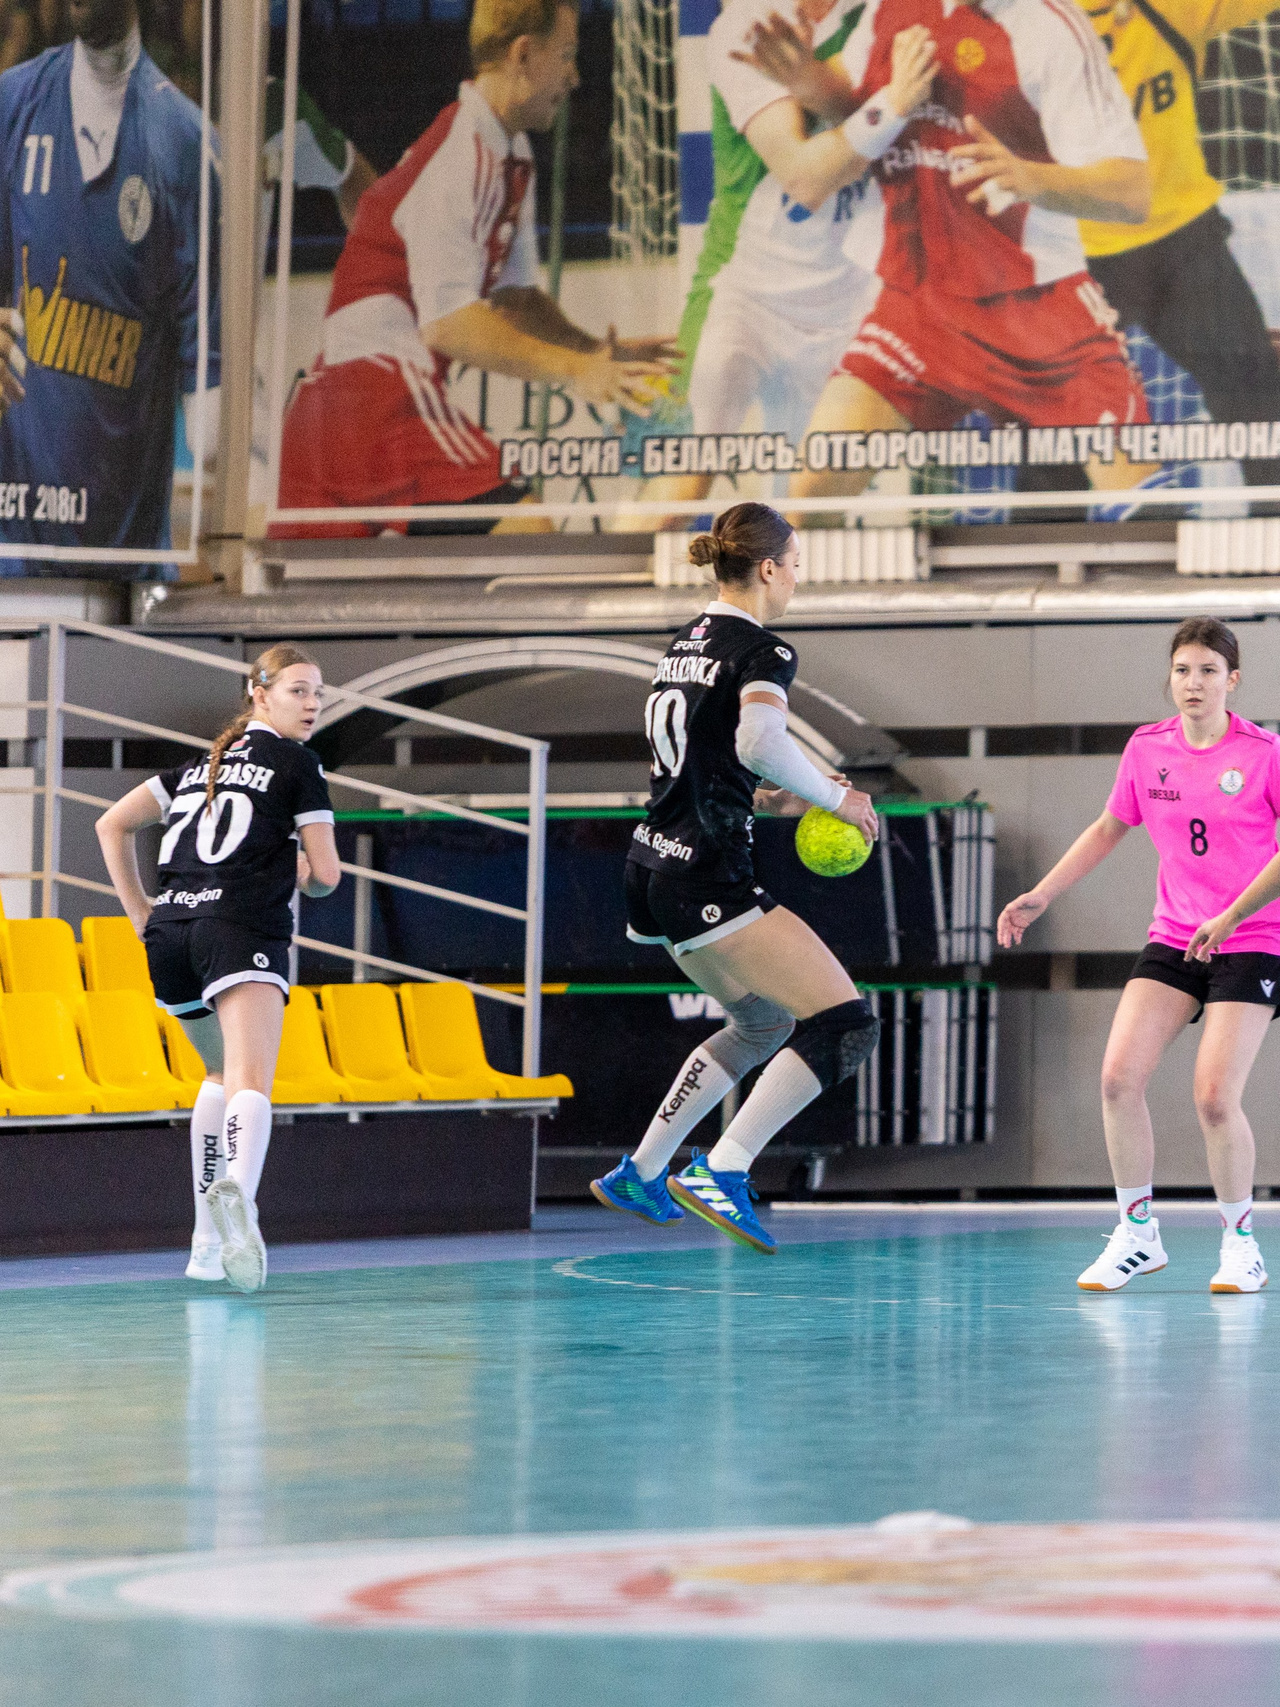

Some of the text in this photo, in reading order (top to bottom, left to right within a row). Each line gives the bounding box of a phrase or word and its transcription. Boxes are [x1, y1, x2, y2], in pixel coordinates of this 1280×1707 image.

[22, 134, 54, 195] 11
[21, 245, 143, 389] WINNER
[501, 437, 621, 478] РОССИЯ
[642, 433, 802, 475] БЕЛАРУСЬ.
[807, 423, 1022, 471] ОТБОРОЧНЫЙ
[1028, 425, 1115, 464] МАТЧ
[157, 790, 254, 866] 70
[652, 833, 693, 861] Region
[1189, 818, 1208, 857] 8
[173, 887, 223, 909] Region
[658, 1058, 708, 1124] Kempa
[198, 1134, 223, 1194] Kempa
